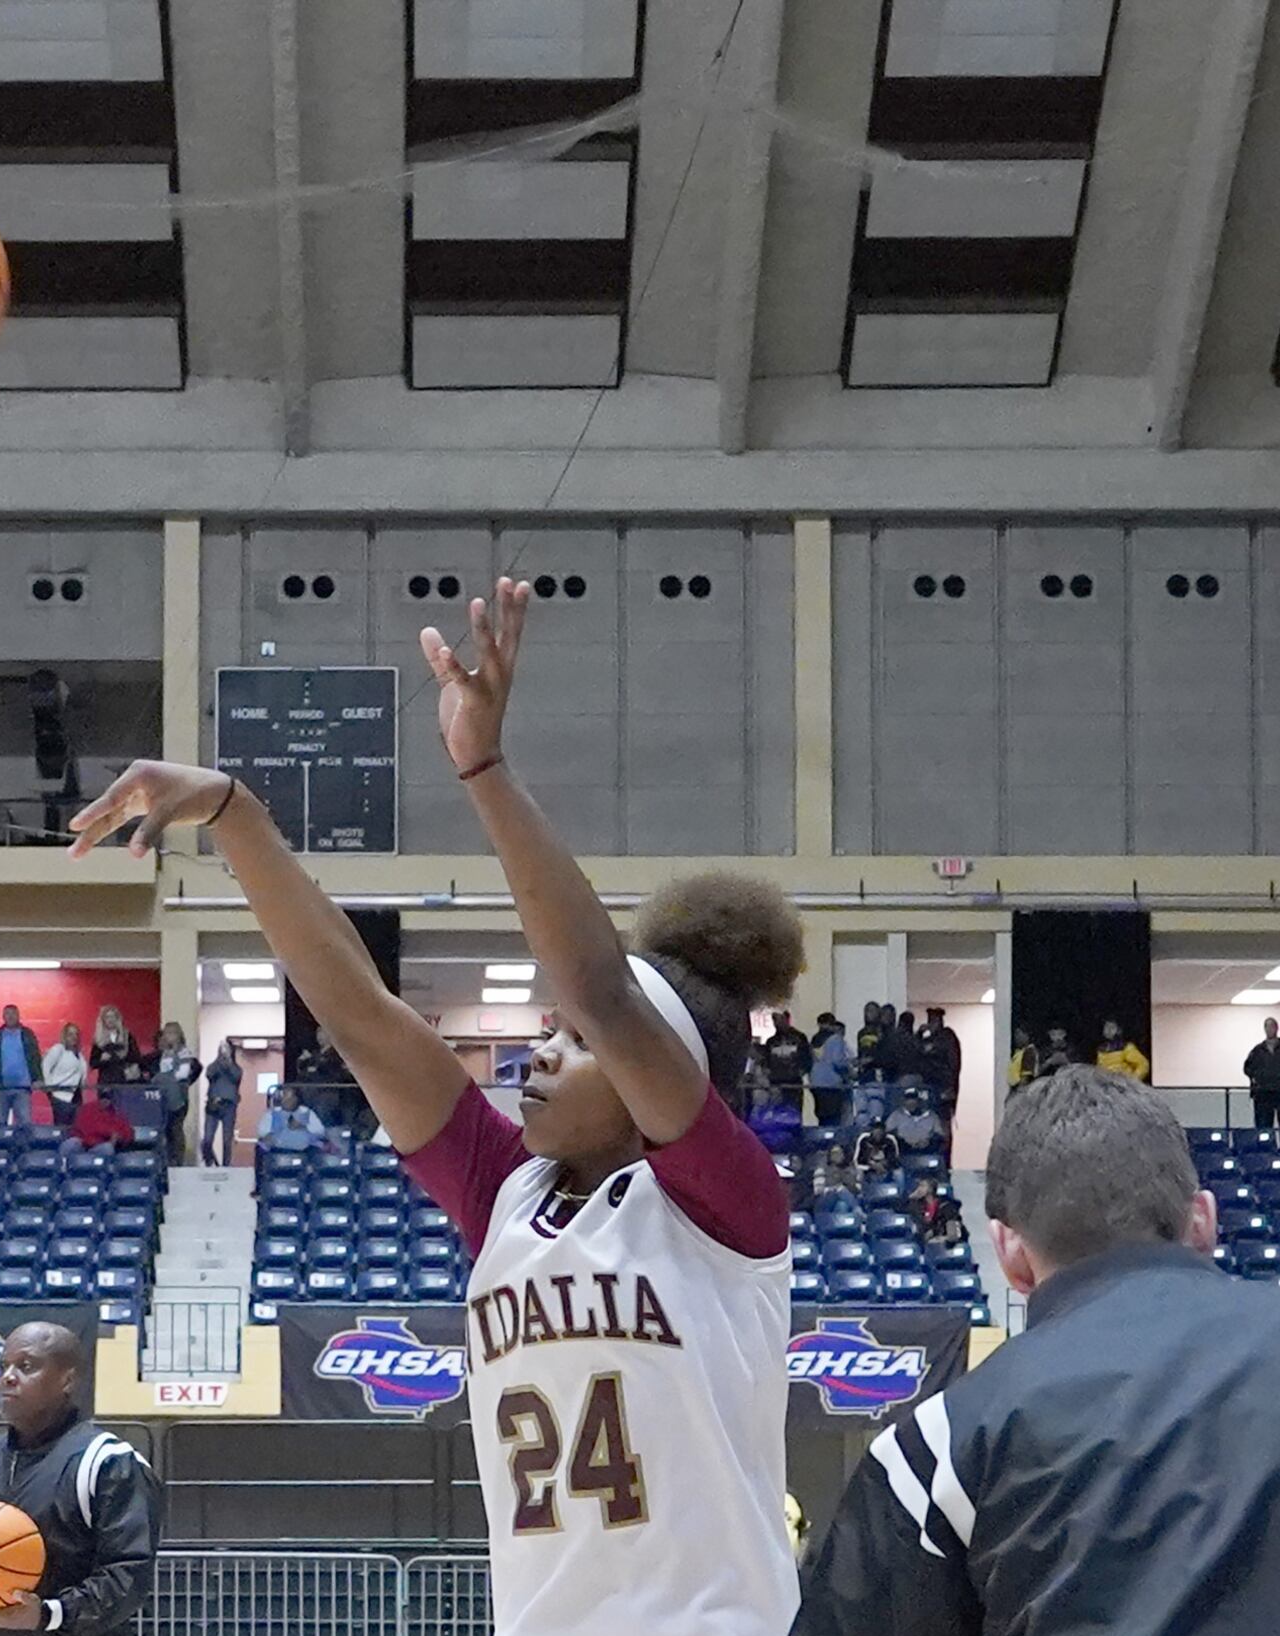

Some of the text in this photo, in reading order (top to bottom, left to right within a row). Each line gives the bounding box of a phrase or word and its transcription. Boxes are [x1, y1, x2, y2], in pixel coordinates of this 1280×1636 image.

[231, 708, 270, 720] HOME
[341, 707, 384, 719] GUEST
[467, 1273, 683, 1374] IDALIA
[320, 1350, 465, 1376] GHSA
[786, 1351, 920, 1377] GHSA
[159, 1385, 223, 1402] EXIT
[497, 1370, 650, 1536] 24
